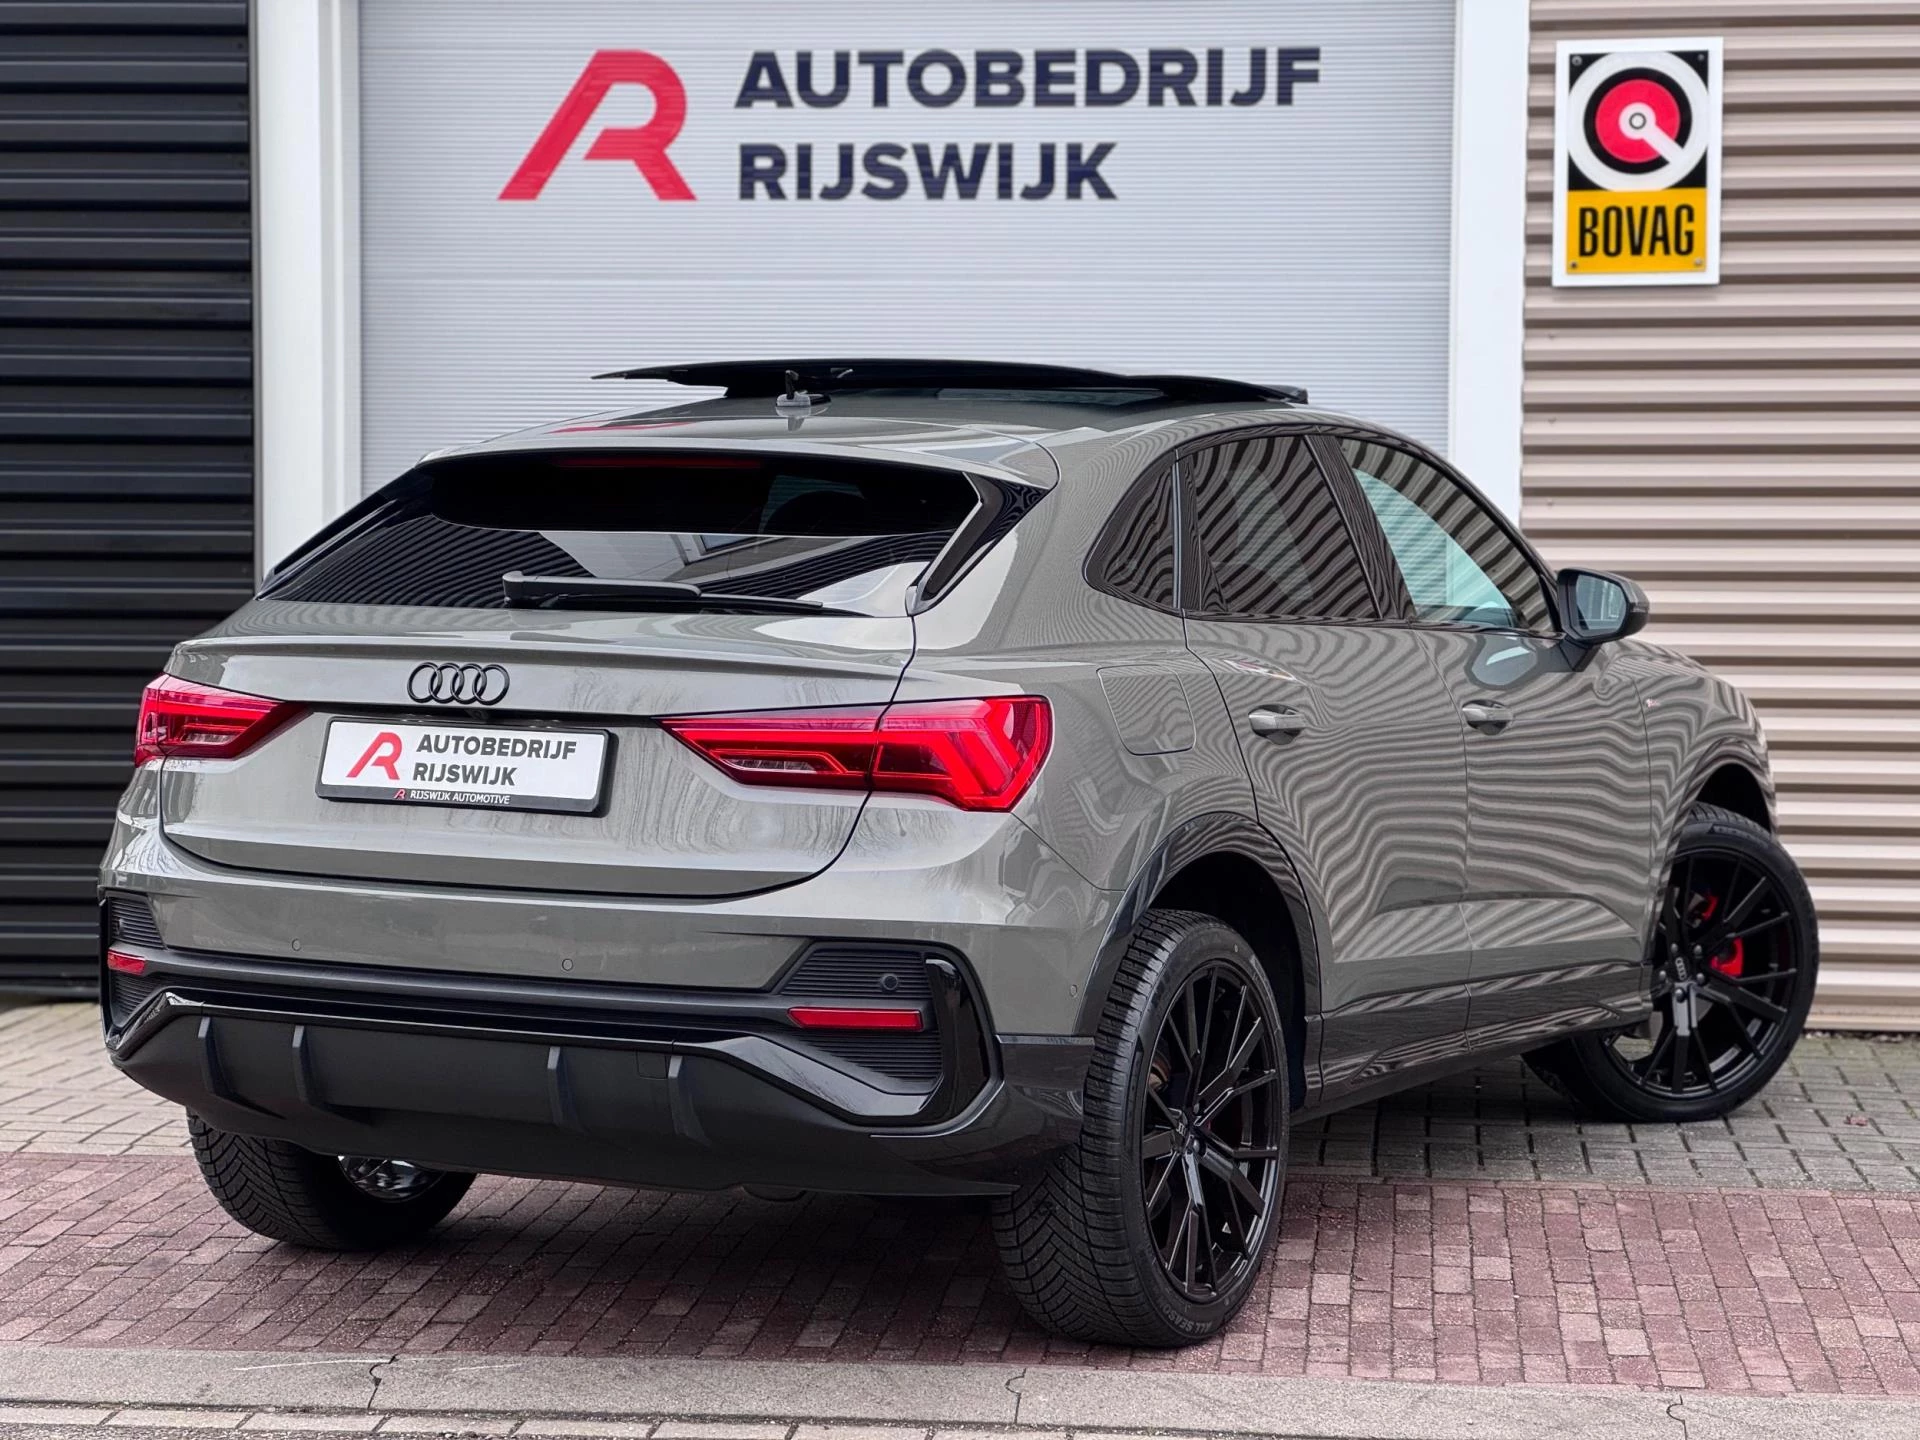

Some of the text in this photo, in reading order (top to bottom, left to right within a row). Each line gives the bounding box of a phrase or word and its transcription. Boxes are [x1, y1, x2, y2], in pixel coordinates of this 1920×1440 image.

[734, 48, 1321, 109] AUTOBEDRIJF
[738, 142, 1118, 201] RIJSWIJK
[1578, 204, 1695, 258] BOVAG
[416, 734, 577, 760] AUTOBEDRIJF
[412, 762, 518, 786] RIJSWIJK
[410, 790, 511, 805] RIJSWIJK AUTOMOTIVE
[1160, 1303, 1196, 1333] SEASO
